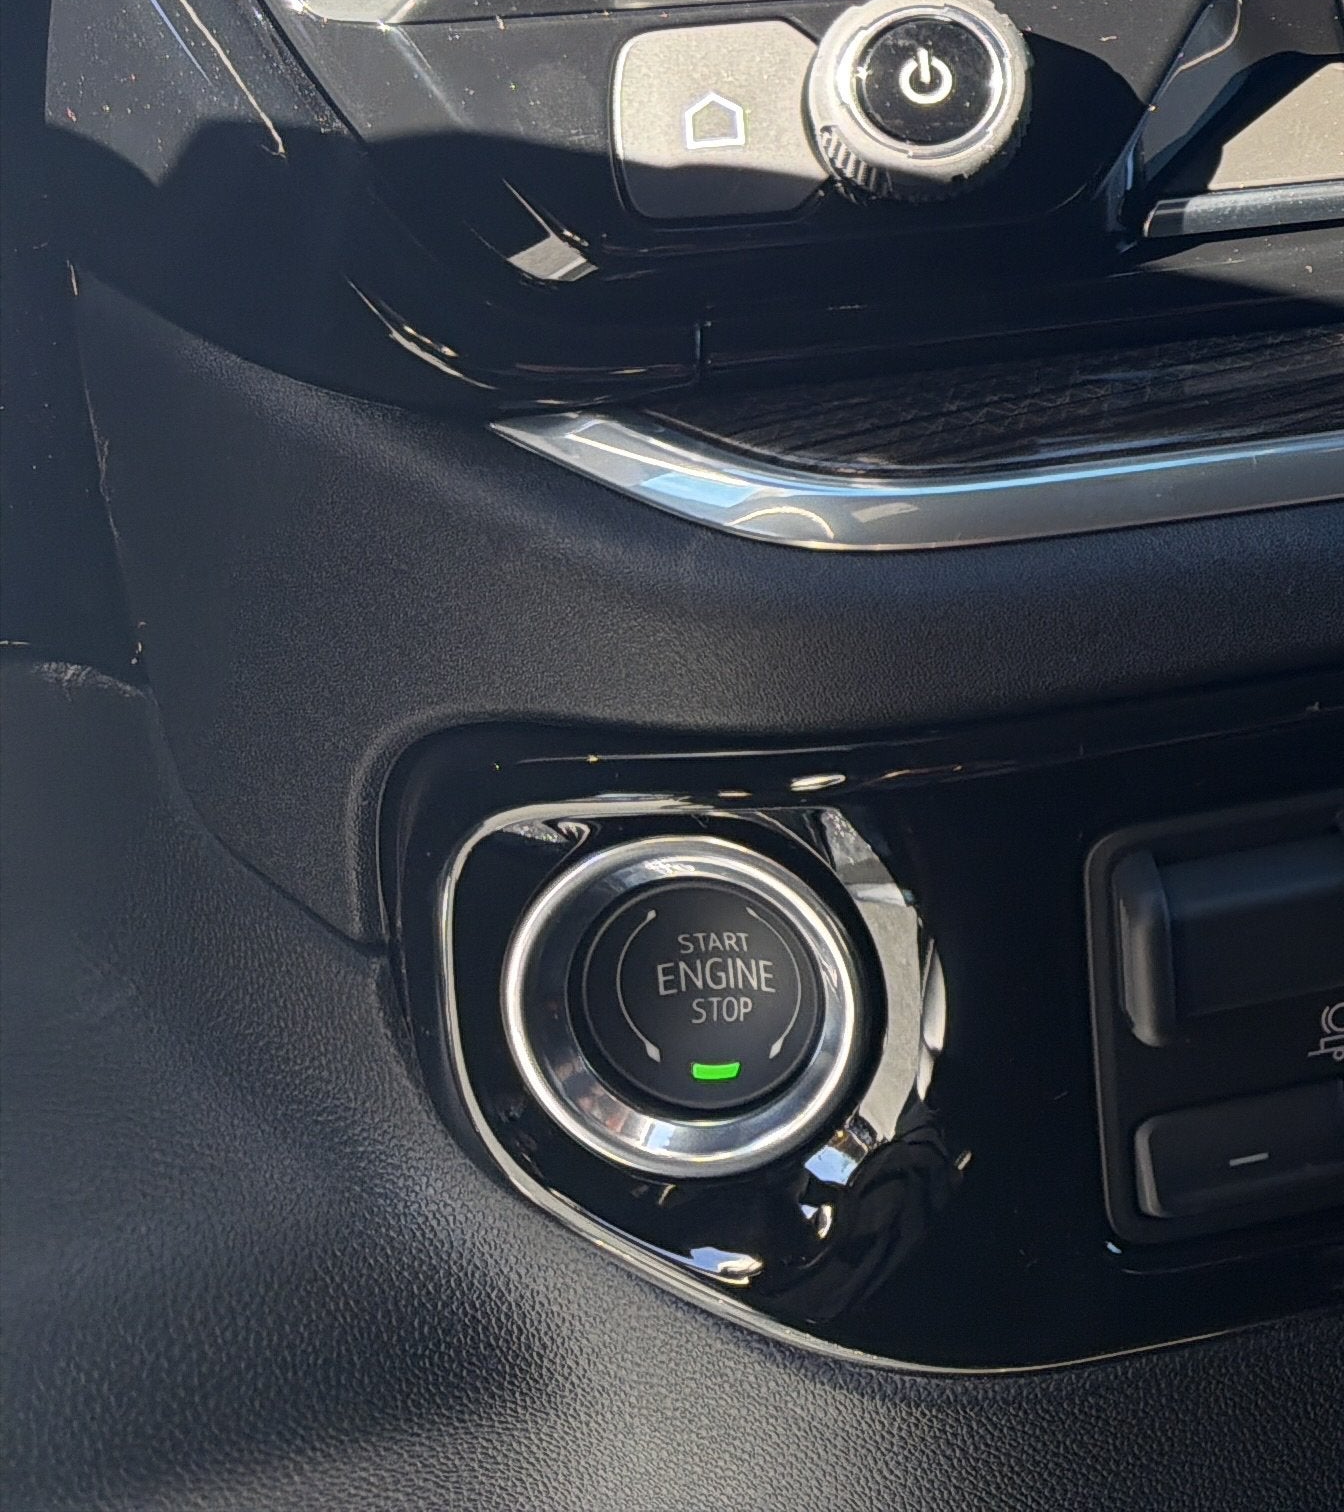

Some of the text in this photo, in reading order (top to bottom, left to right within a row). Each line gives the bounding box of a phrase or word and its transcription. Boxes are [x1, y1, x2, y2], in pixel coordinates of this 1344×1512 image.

[677, 931, 750, 955] START
[656, 957, 776, 996] ENGINE
[691, 996, 753, 1024] STOP
